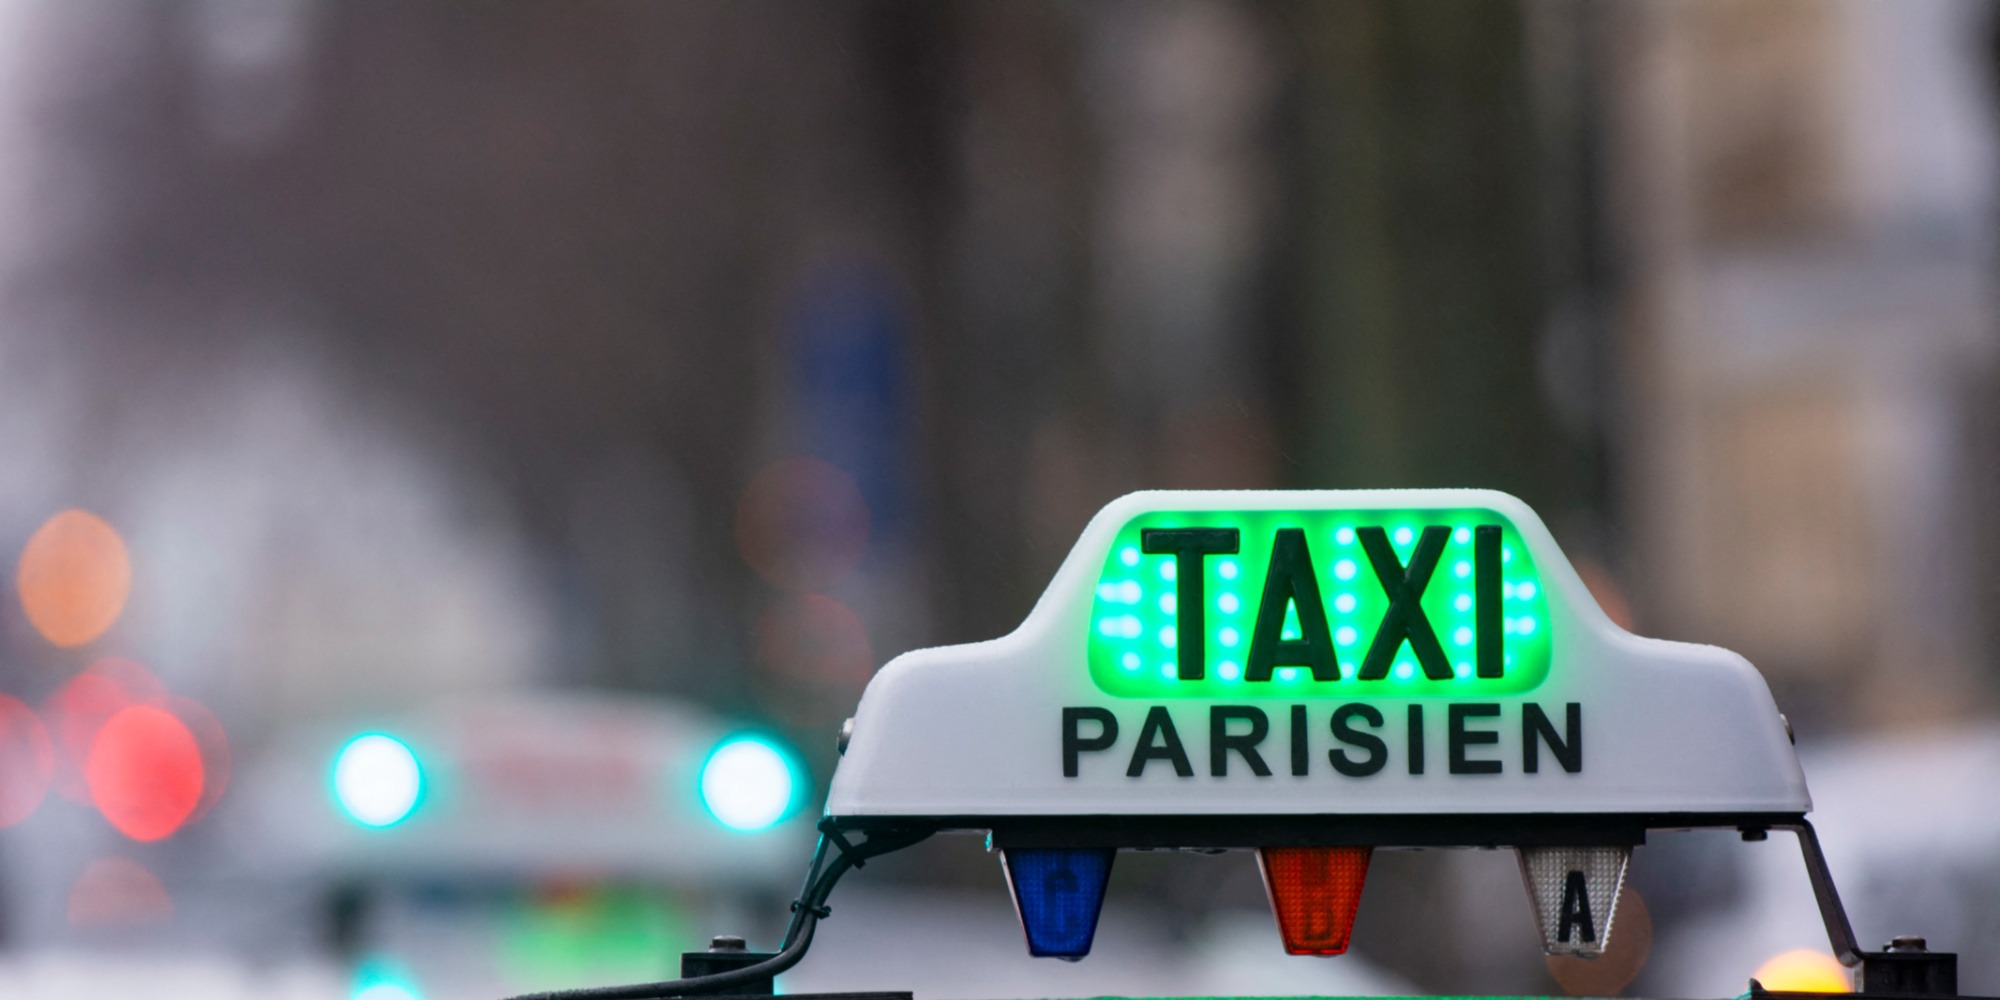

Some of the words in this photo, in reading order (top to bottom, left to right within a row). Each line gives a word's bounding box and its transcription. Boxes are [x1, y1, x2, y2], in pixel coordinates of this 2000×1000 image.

[1141, 525, 1504, 681] TAXI
[1062, 702, 1582, 777] PARISIEN
[1558, 870, 1596, 943] A
